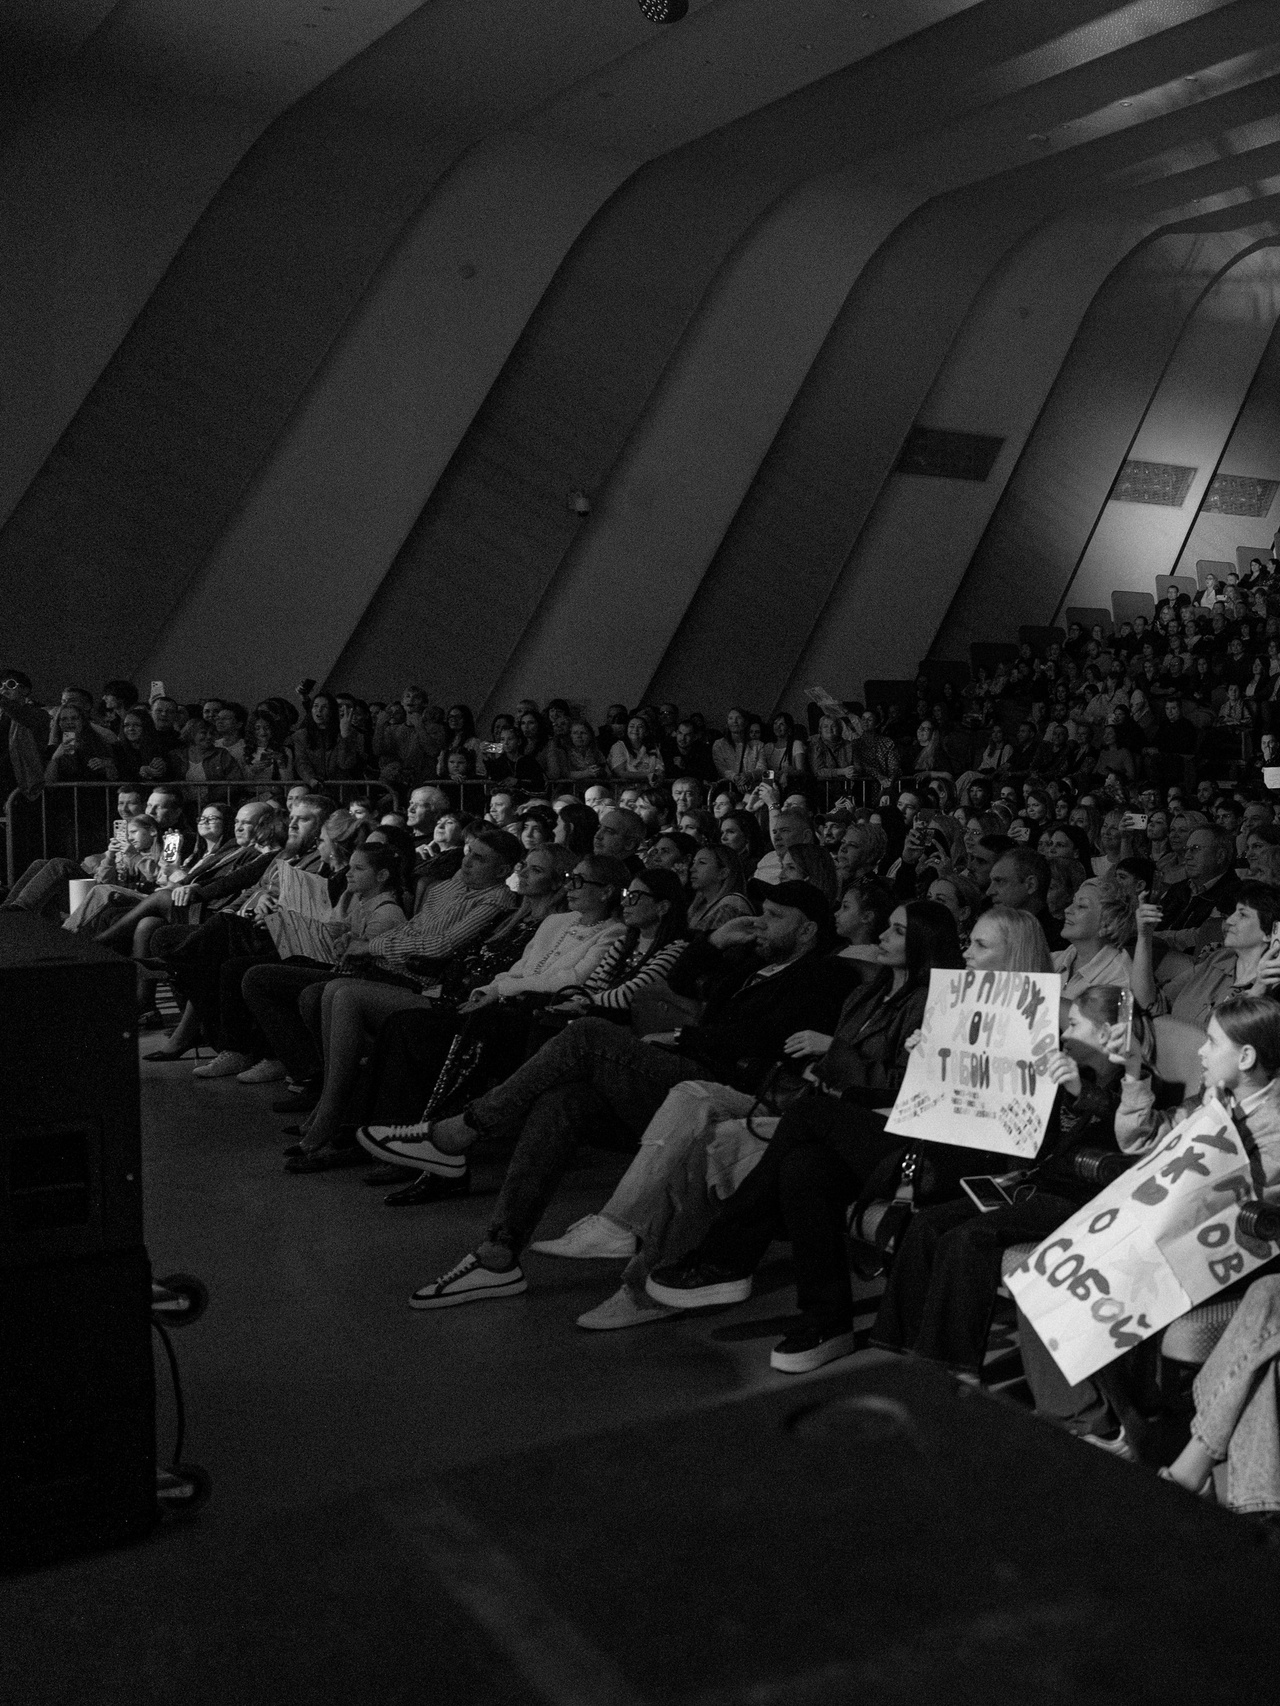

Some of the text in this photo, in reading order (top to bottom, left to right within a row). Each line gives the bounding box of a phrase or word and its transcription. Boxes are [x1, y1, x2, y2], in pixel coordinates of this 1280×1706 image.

[951, 1007, 1010, 1051] ХОЧУ
[937, 1047, 991, 1090] ТОБОЙ
[990, 1056, 1037, 1098] ФОТО
[1034, 1237, 1153, 1350] СОБОЙ
